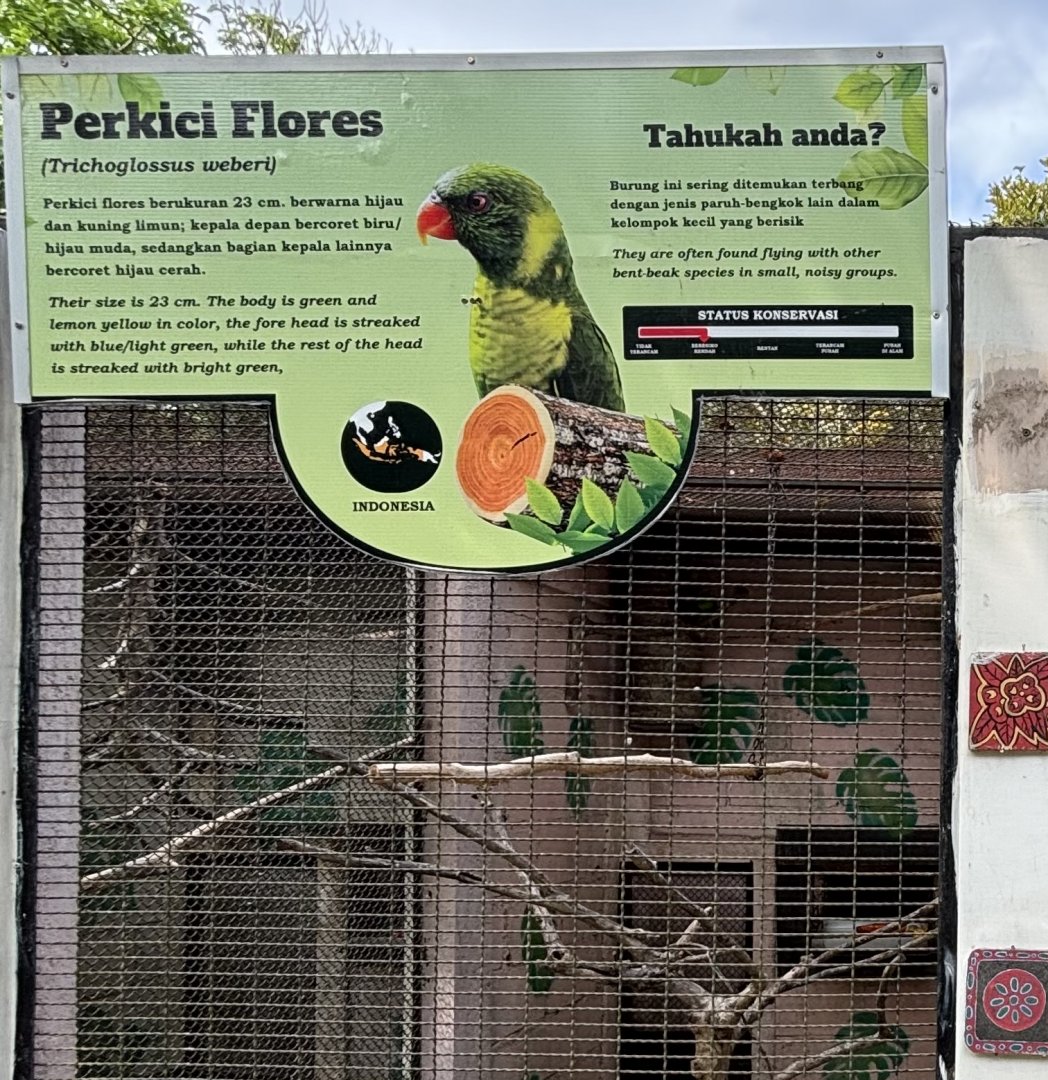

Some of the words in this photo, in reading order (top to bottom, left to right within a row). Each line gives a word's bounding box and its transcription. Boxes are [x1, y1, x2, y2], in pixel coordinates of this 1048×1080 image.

[39, 100, 217, 139] Perkici
[230, 100, 383, 138] Flores
[643, 122, 783, 148] Tahukah
[791, 121, 886, 146] anda?
[41, 156, 194, 177] (Trichoglossus
[202, 156, 276, 175] weberi)
[609, 180, 659, 193] Burung
[663, 179, 682, 190] ini
[686, 179, 728, 192] sering
[732, 178, 807, 189] ditemukan
[811, 178, 864, 192] terbang
[42, 197, 97, 209] Perkici
[102, 197, 145, 208] flores
[148, 196, 228, 208] berukuran
[232, 196, 252, 208] 23
[289, 195, 360, 207] berwarna
[364, 194, 403, 209] hijau
[610, 198, 659, 212] dengan
[662, 198, 696, 211] jenis
[701, 197, 803, 211] paruh-bengkok
[807, 196, 833, 207] lain
[838, 194, 879, 207] dalam
[44, 219, 72, 231] dan
[76, 220, 131, 234] kuning
[135, 219, 185, 232] limun;
[190, 218, 240, 233] kepala
[244, 218, 290, 233] depan
[294, 218, 359, 229] bercoret
[362, 217, 401, 230] biru/
[610, 216, 678, 230] kelompok
[682, 216, 715, 226] kecil
[719, 218, 753, 229] yang
[756, 215, 804, 226] berisik
[45, 242, 84, 257] hijau
[89, 242, 136, 255] muda,
[141, 241, 222, 256] sedangkan
[226, 240, 276, 255] bagian
[281, 239, 331, 255] kepala
[335, 239, 392, 254] lainnya
[612, 248, 645, 262] They
[677, 247, 713, 261] often
[715, 247, 757, 261] found
[759, 247, 803, 260] flying
[807, 247, 838, 257] with
[843, 247, 881, 257] other
[45, 264, 110, 276] bercoret
[115, 264, 154, 278] hijau
[158, 263, 205, 275] cerah.
[612, 266, 679, 278] bent-beak
[683, 267, 734, 280] species
[739, 266, 752, 277] in
[757, 266, 799, 279] small,
[805, 266, 842, 279] noisy
[845, 269, 897, 280] groups.
[48, 296, 91, 308] Their
[95, 296, 125, 307] size
[130, 296, 144, 307] is
[149, 295, 169, 307] 23
[206, 295, 235, 306] The
[239, 294, 276, 309] body
[281, 294, 294, 306] is
[299, 297, 342, 309] green
[347, 293, 377, 305] and
[698, 310, 749, 320] STATUS
[753, 309, 838, 320] KONSERVASI
[49, 318, 96, 330] lemon
[100, 318, 151, 332] yellow
[156, 318, 172, 329] in
[176, 317, 220, 331] color,
[225, 317, 250, 328] the
[252, 316, 285, 331] fore
[290, 316, 329, 328] head
[334, 316, 347, 327] is
[351, 315, 420, 327] streaked
[50, 340, 85, 351] with
[90, 339, 166, 354] blue/light
[170, 342, 217, 354] green,
[224, 339, 266, 350] while
[270, 338, 295, 350] the
[300, 339, 330, 350] rest
[334, 338, 352, 353] of
[354, 338, 379, 349] the
[384, 337, 422, 349] head
[51, 362, 65, 373] is
[69, 362, 138, 373] streaked
[144, 361, 178, 373] with
[183, 361, 231, 376] bright
[235, 364, 283, 375] green,
[352, 500, 435, 512] INDONESIA
